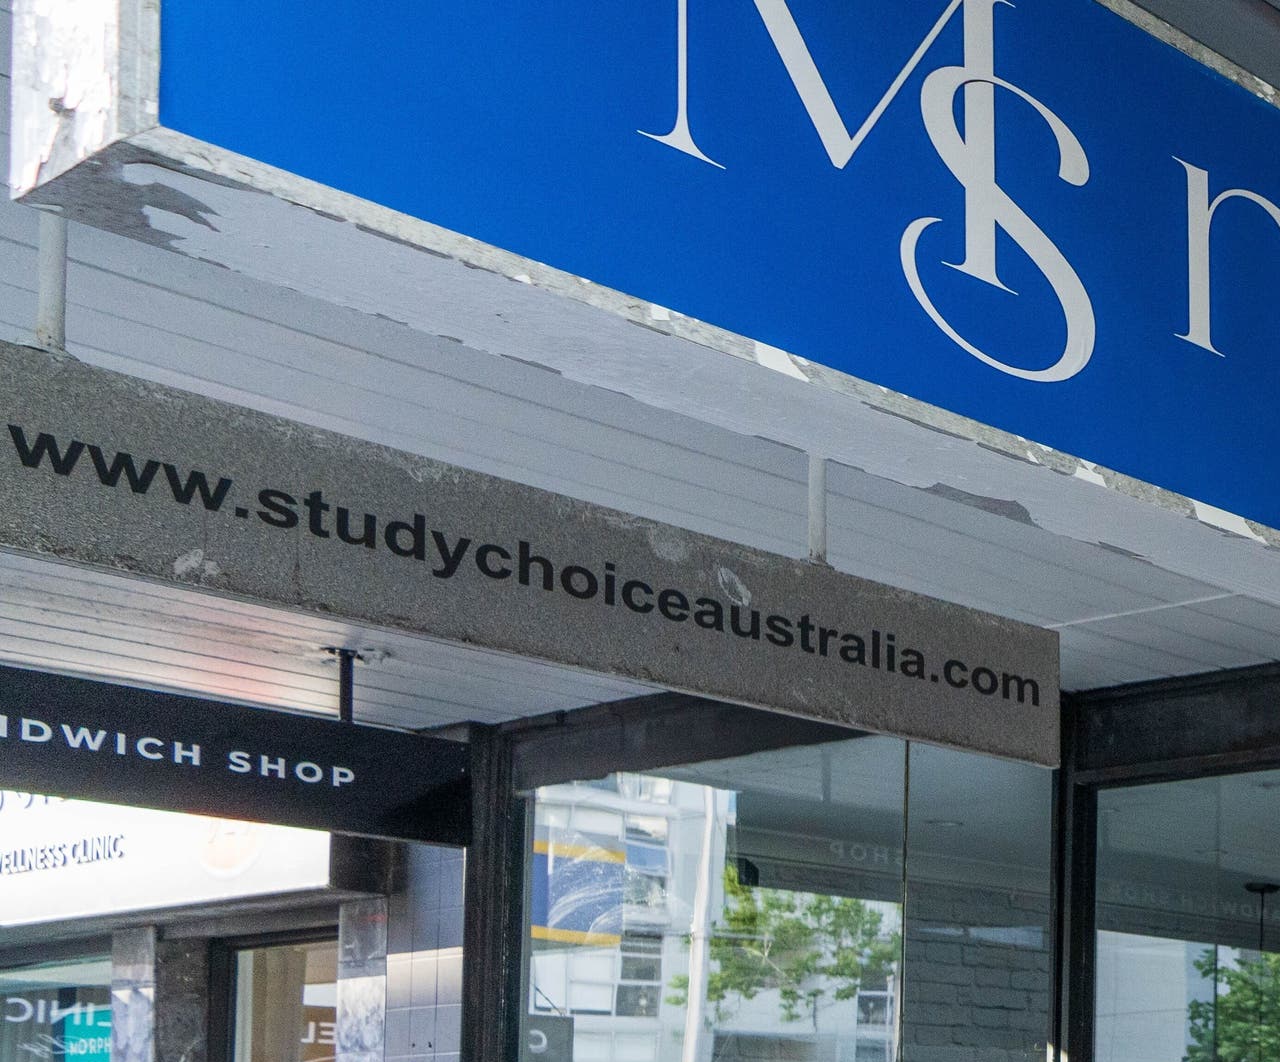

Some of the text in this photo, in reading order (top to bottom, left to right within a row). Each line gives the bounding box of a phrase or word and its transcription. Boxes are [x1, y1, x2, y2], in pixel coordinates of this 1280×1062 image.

[7, 423, 1041, 708] www.studychoiceaustralia.com
[0, 717, 356, 789] DWICH SHOP
[72, 834, 125, 865] CLINIC
